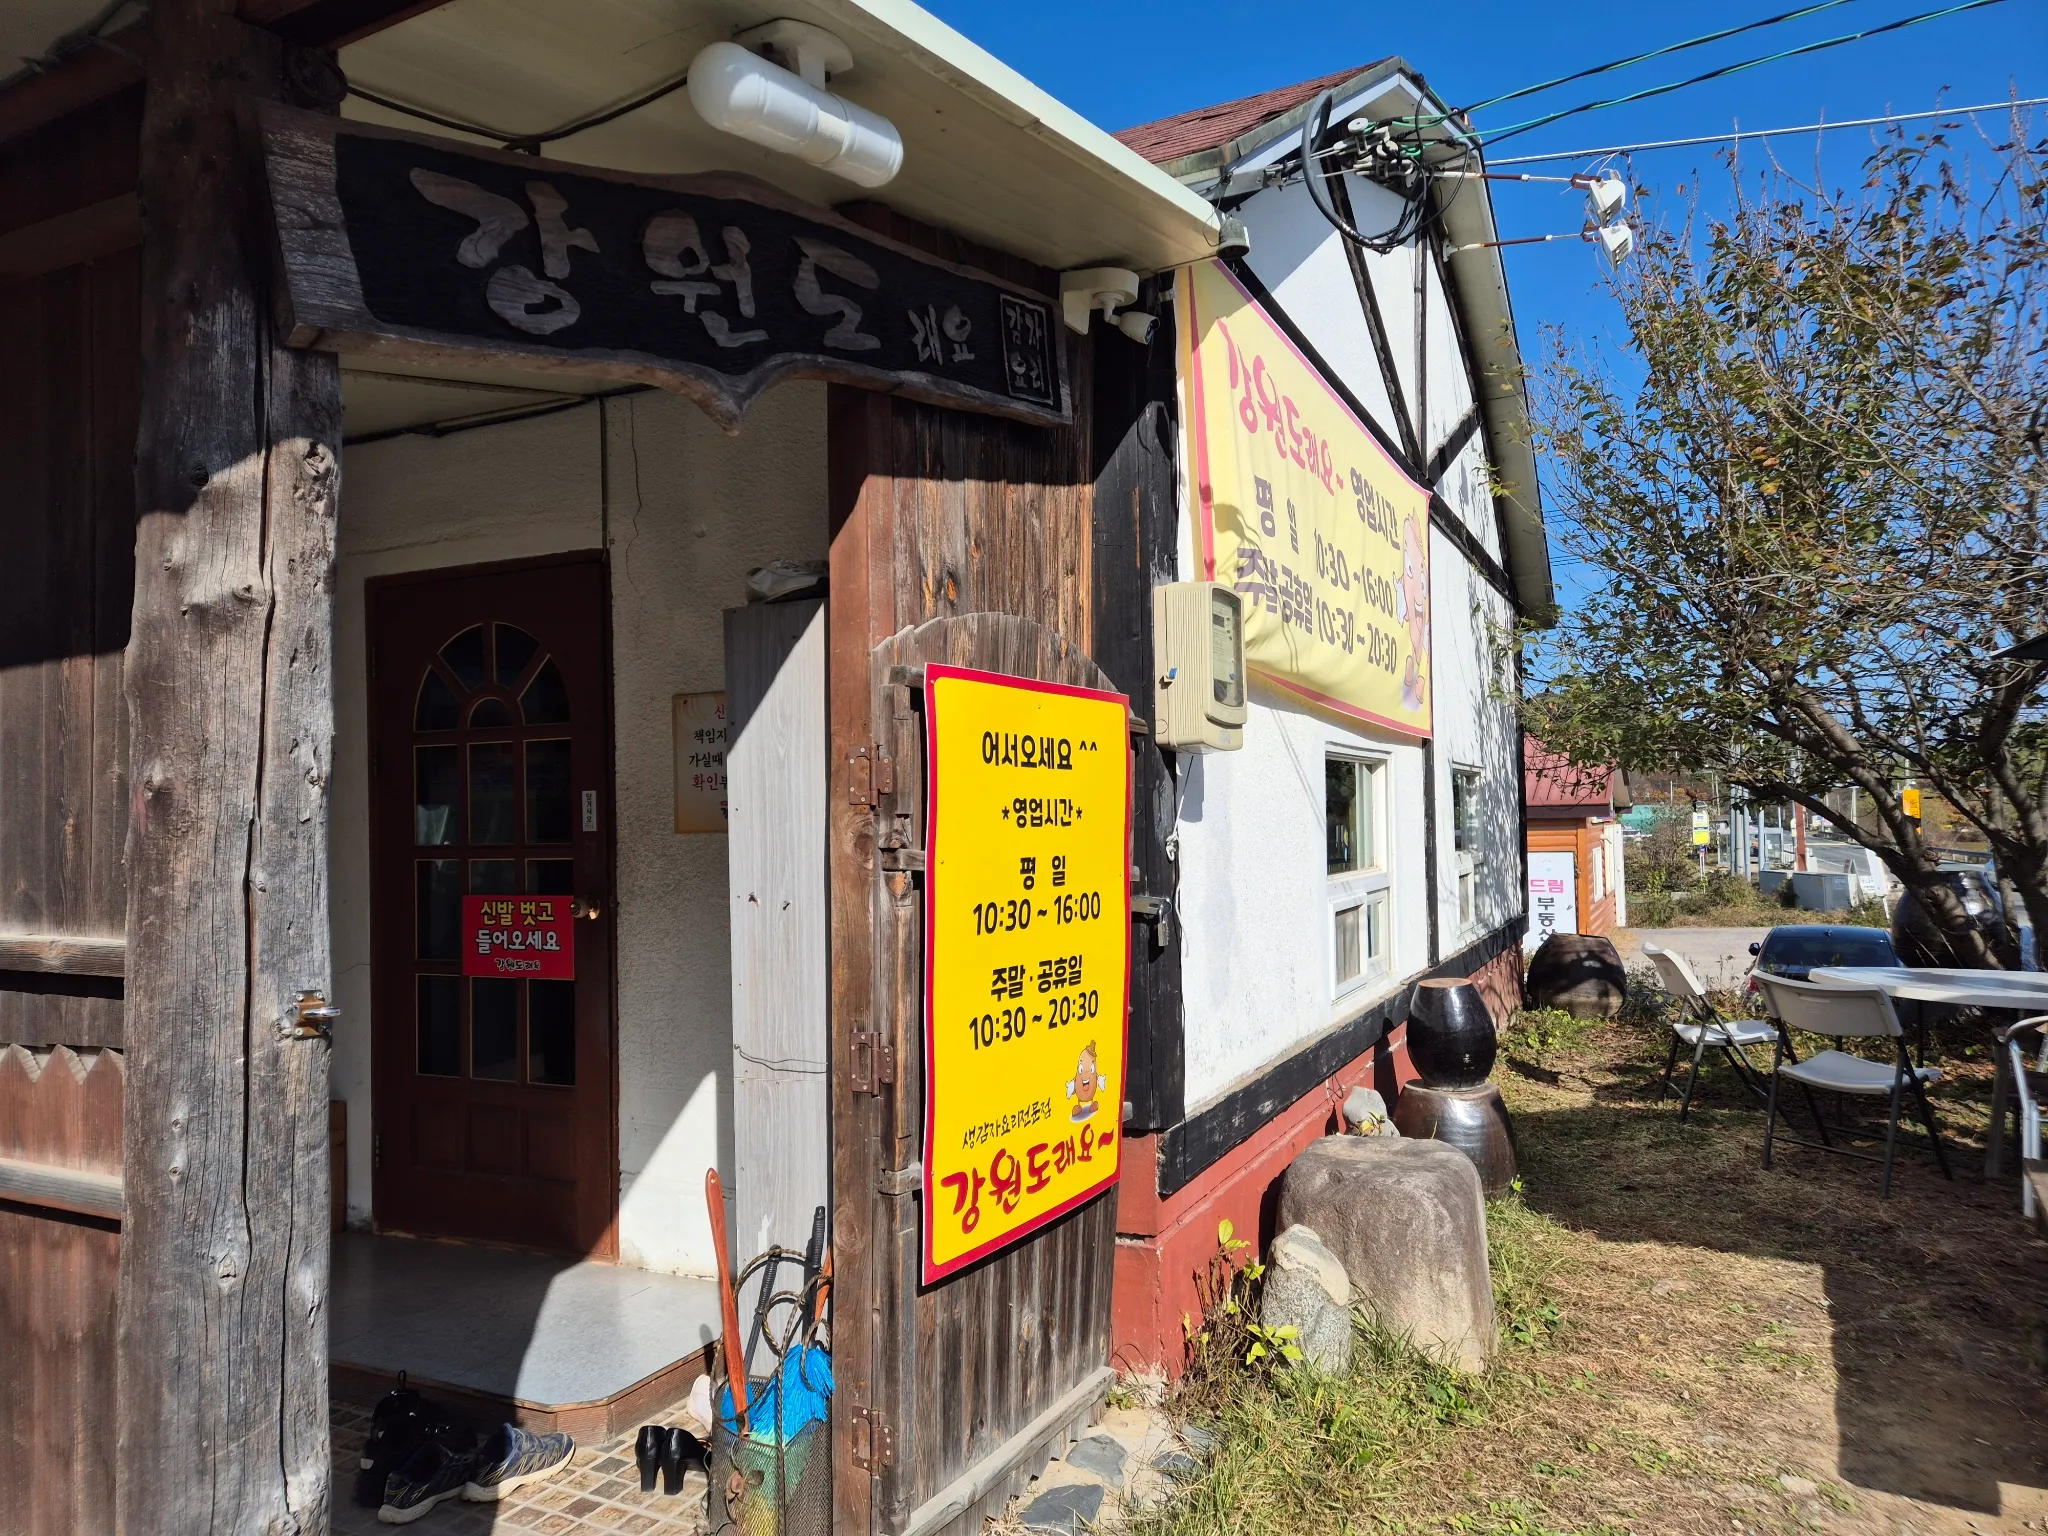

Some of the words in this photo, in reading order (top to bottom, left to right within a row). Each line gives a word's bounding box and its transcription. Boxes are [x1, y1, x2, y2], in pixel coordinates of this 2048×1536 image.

[1350, 466, 1400, 550] 영업시간
[688, 751, 723, 768] 가실때
[982, 731, 1072, 770] 어서오세요
[1530, 879, 1564, 893] 드림
[480, 901, 515, 926] 신발
[520, 901, 554, 926] 벗고
[475, 929, 561, 954] 들어오세요
[962, 1096, 1052, 1149] 생감자요리전문점
